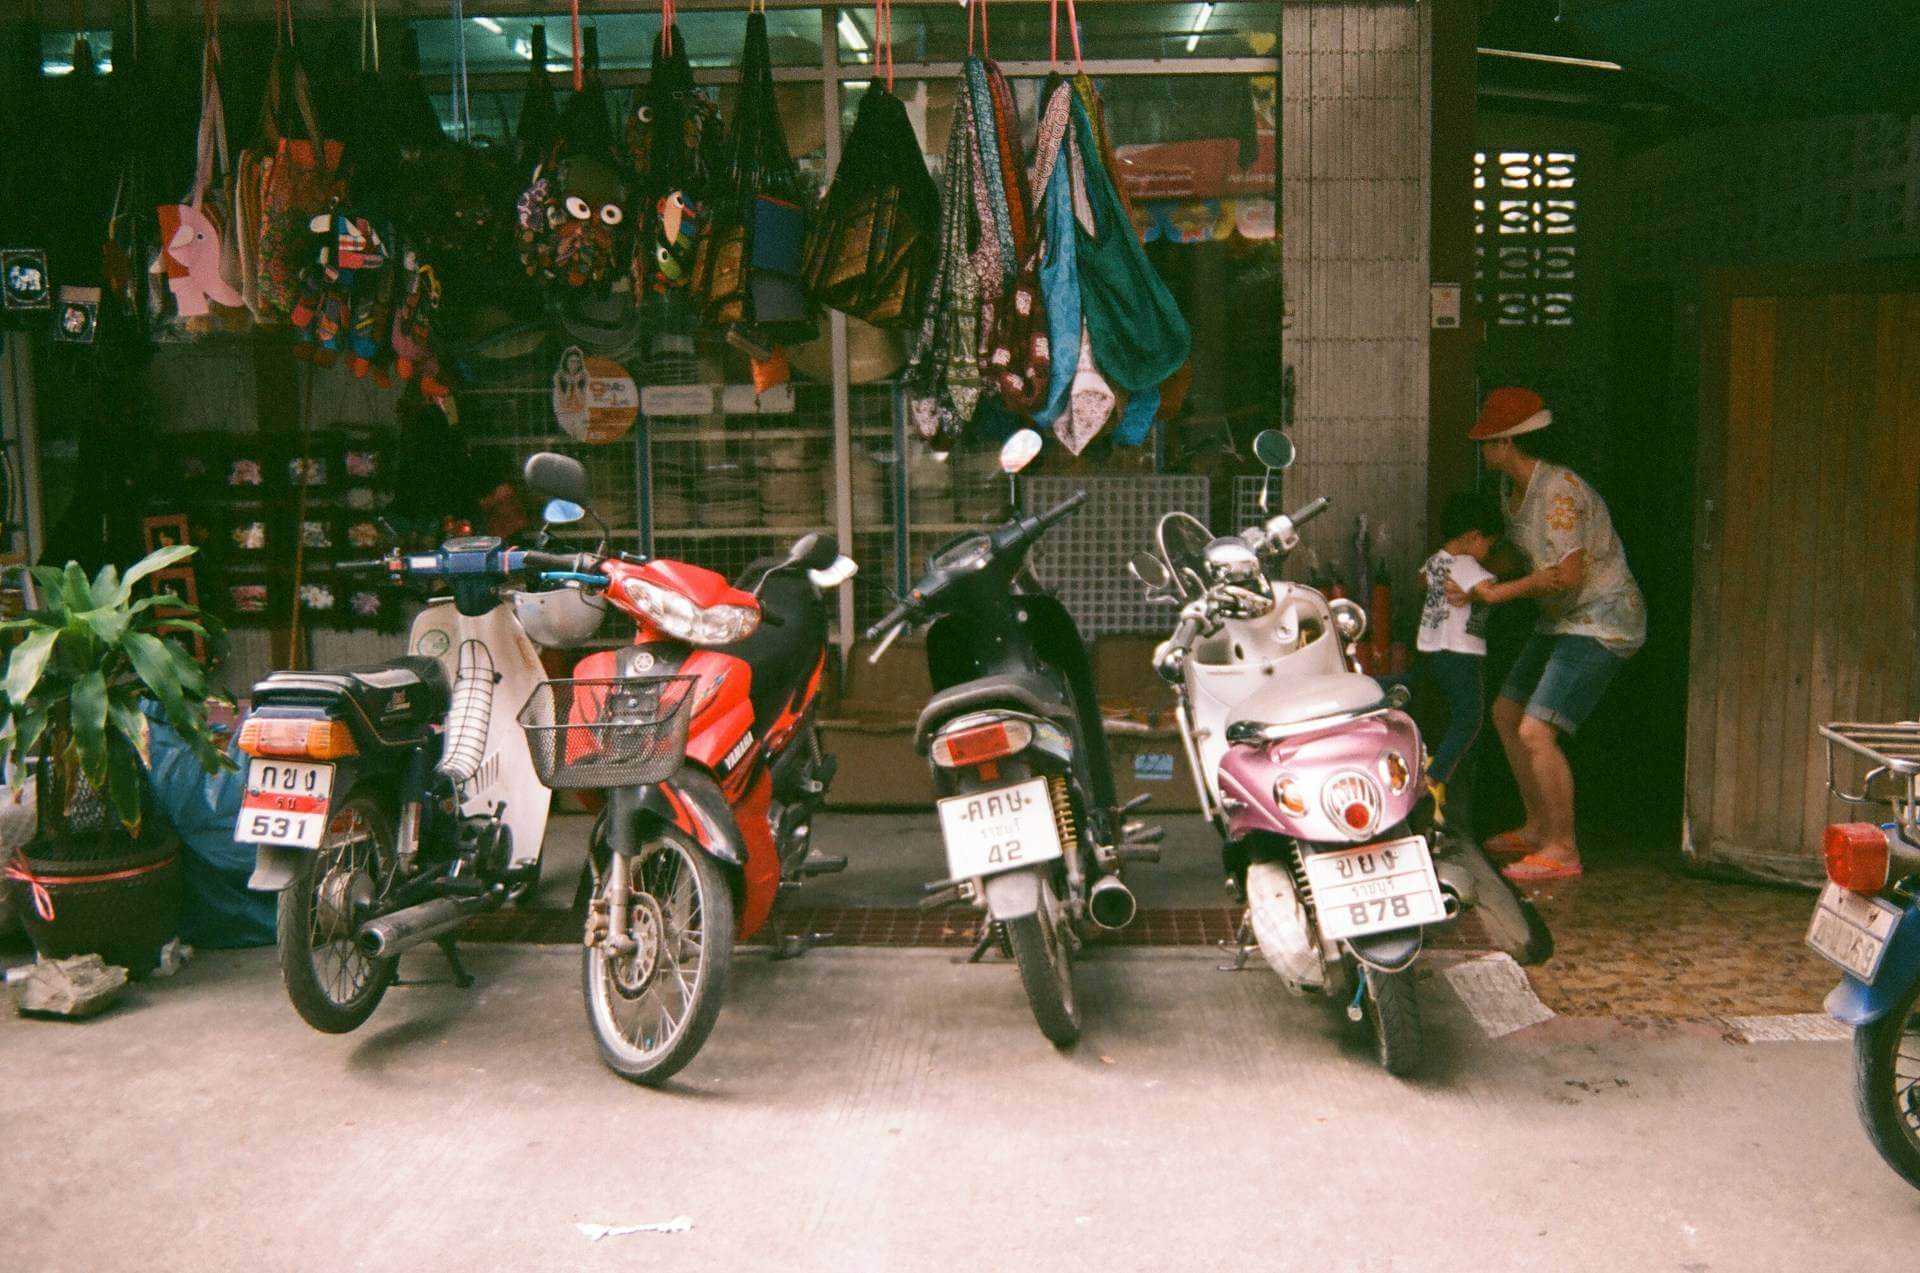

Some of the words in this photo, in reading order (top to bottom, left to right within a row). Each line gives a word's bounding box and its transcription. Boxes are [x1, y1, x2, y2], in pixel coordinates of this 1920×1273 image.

[261, 766, 317, 791] กขง
[251, 815, 307, 839] 531
[988, 840, 1023, 863] 42
[1349, 895, 1410, 925] 878
